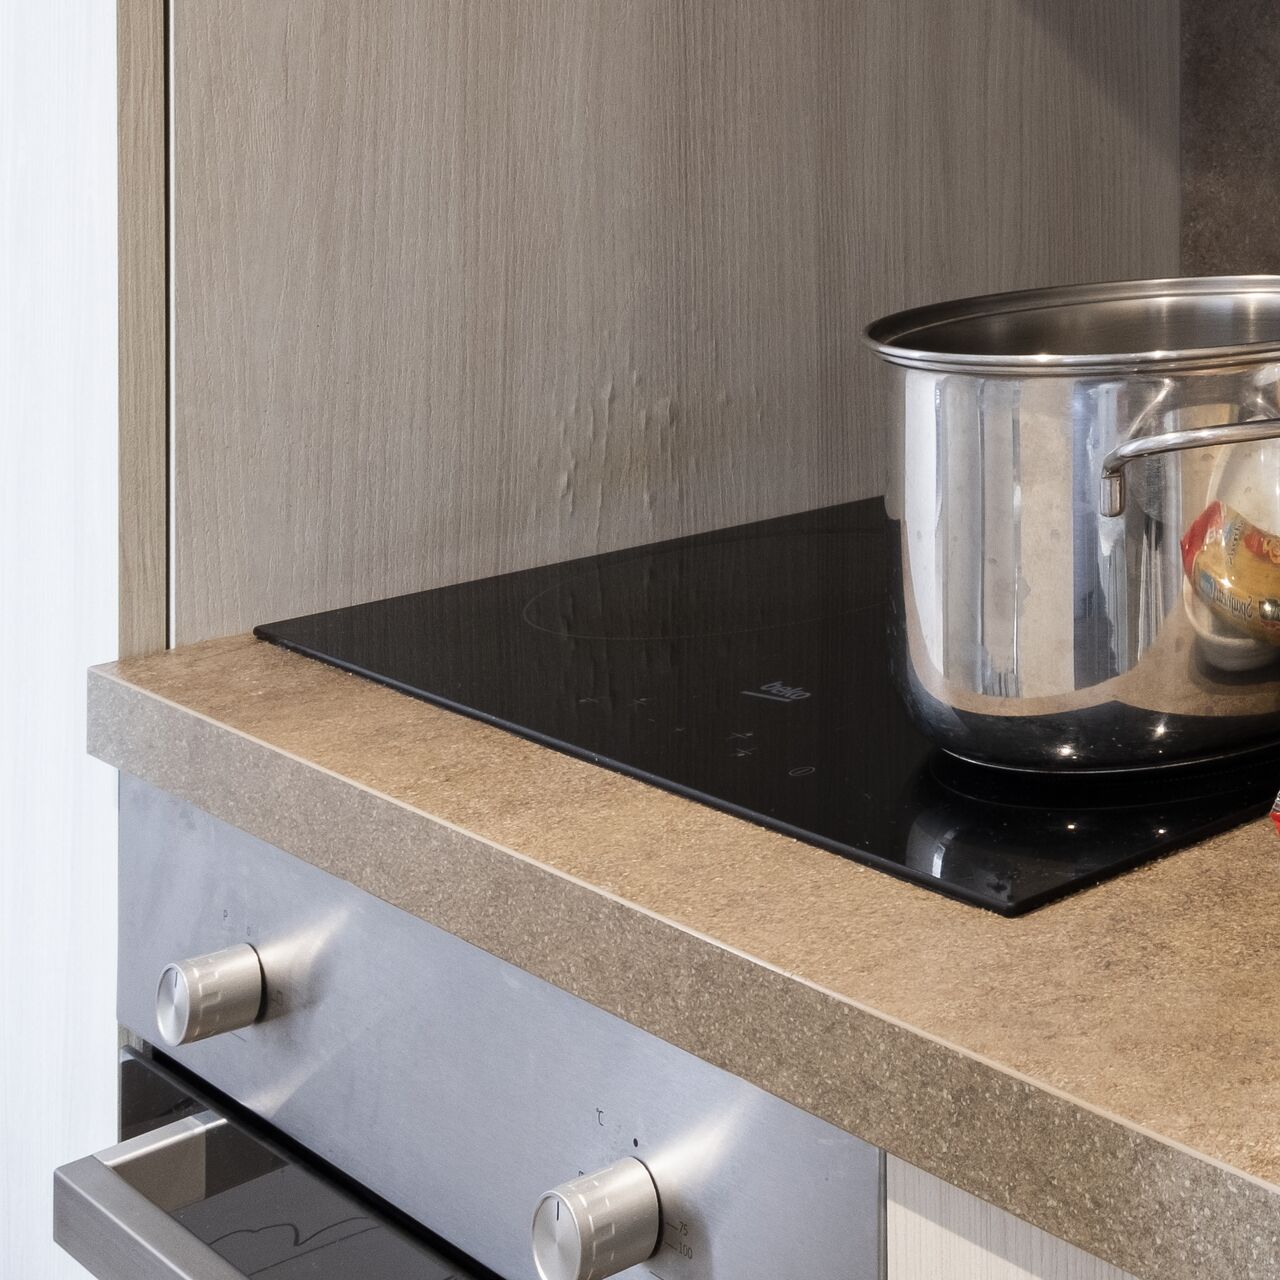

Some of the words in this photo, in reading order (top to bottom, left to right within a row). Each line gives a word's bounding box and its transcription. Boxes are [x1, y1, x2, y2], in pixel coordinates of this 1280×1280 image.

[761, 681, 811, 700] beko
[679, 1221, 689, 1237] 75
[679, 1243, 693, 1260] 100
